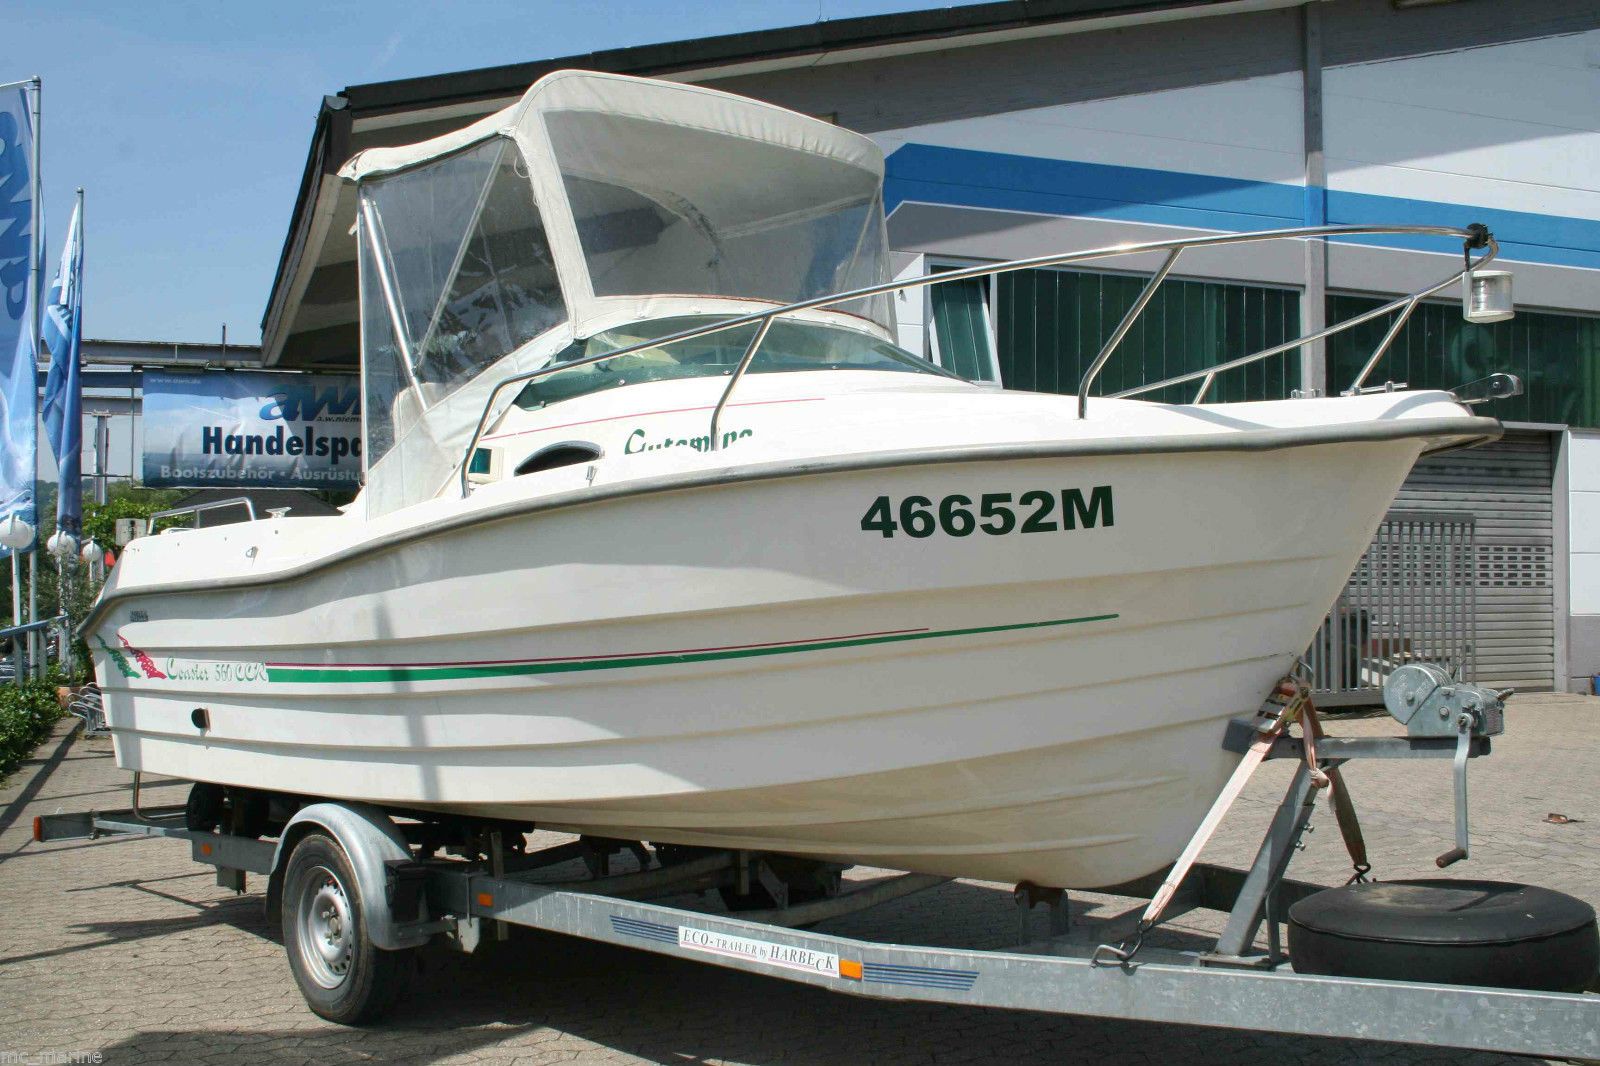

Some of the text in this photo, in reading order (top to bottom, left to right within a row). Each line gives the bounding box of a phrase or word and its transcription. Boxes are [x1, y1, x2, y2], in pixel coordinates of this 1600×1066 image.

[161, 465, 273, 480] Bootszubehör
[860, 486, 1115, 539] 46652M
[770, 945, 834, 972] HARBECK
